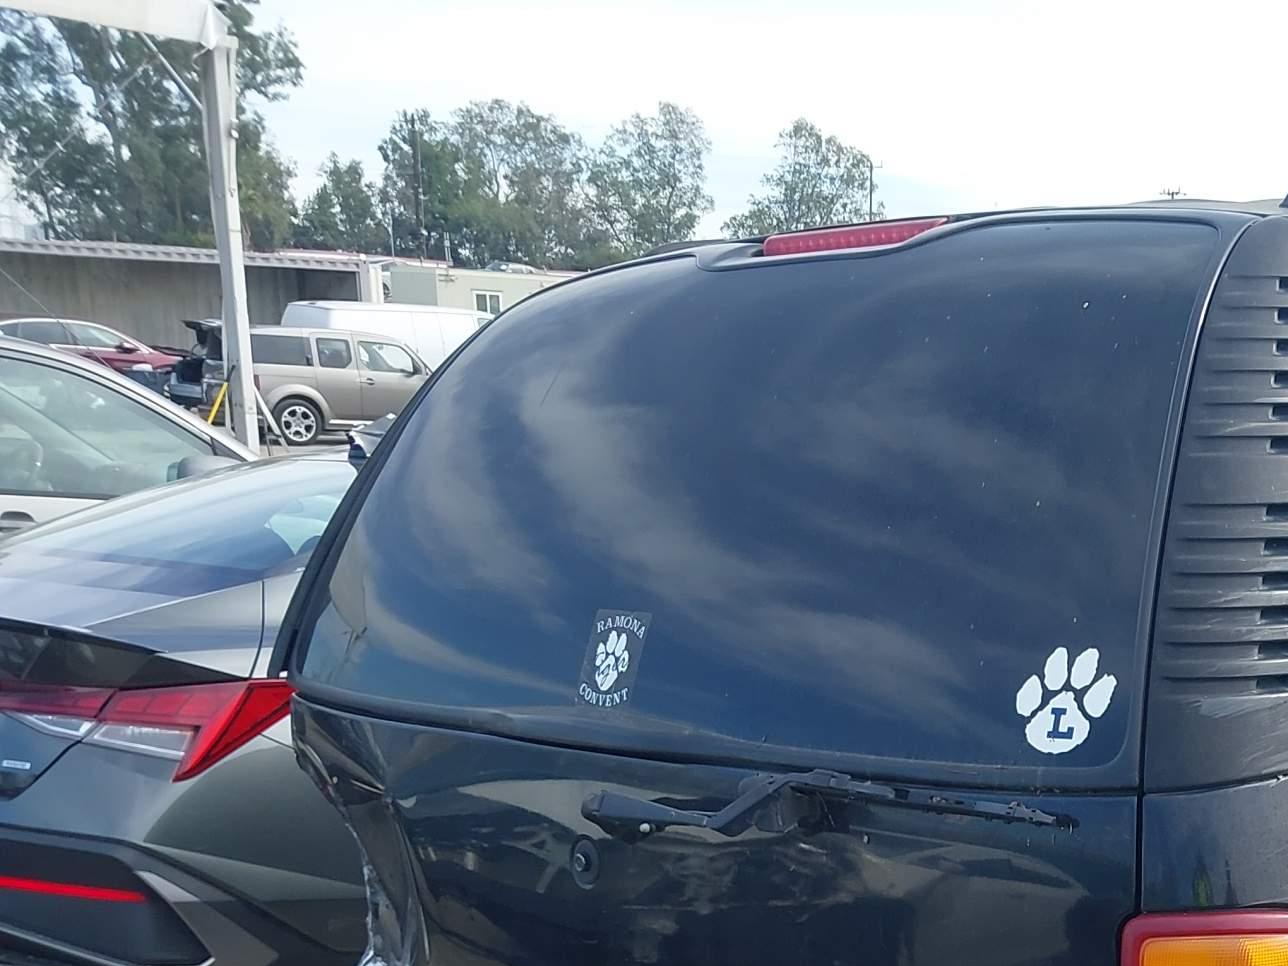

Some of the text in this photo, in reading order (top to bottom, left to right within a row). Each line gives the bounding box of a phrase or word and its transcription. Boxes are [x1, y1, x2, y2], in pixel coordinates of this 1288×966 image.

[597, 615, 646, 639] RAMONA
[579, 683, 629, 707] CONVENT
[1047, 708, 1075, 740] L
